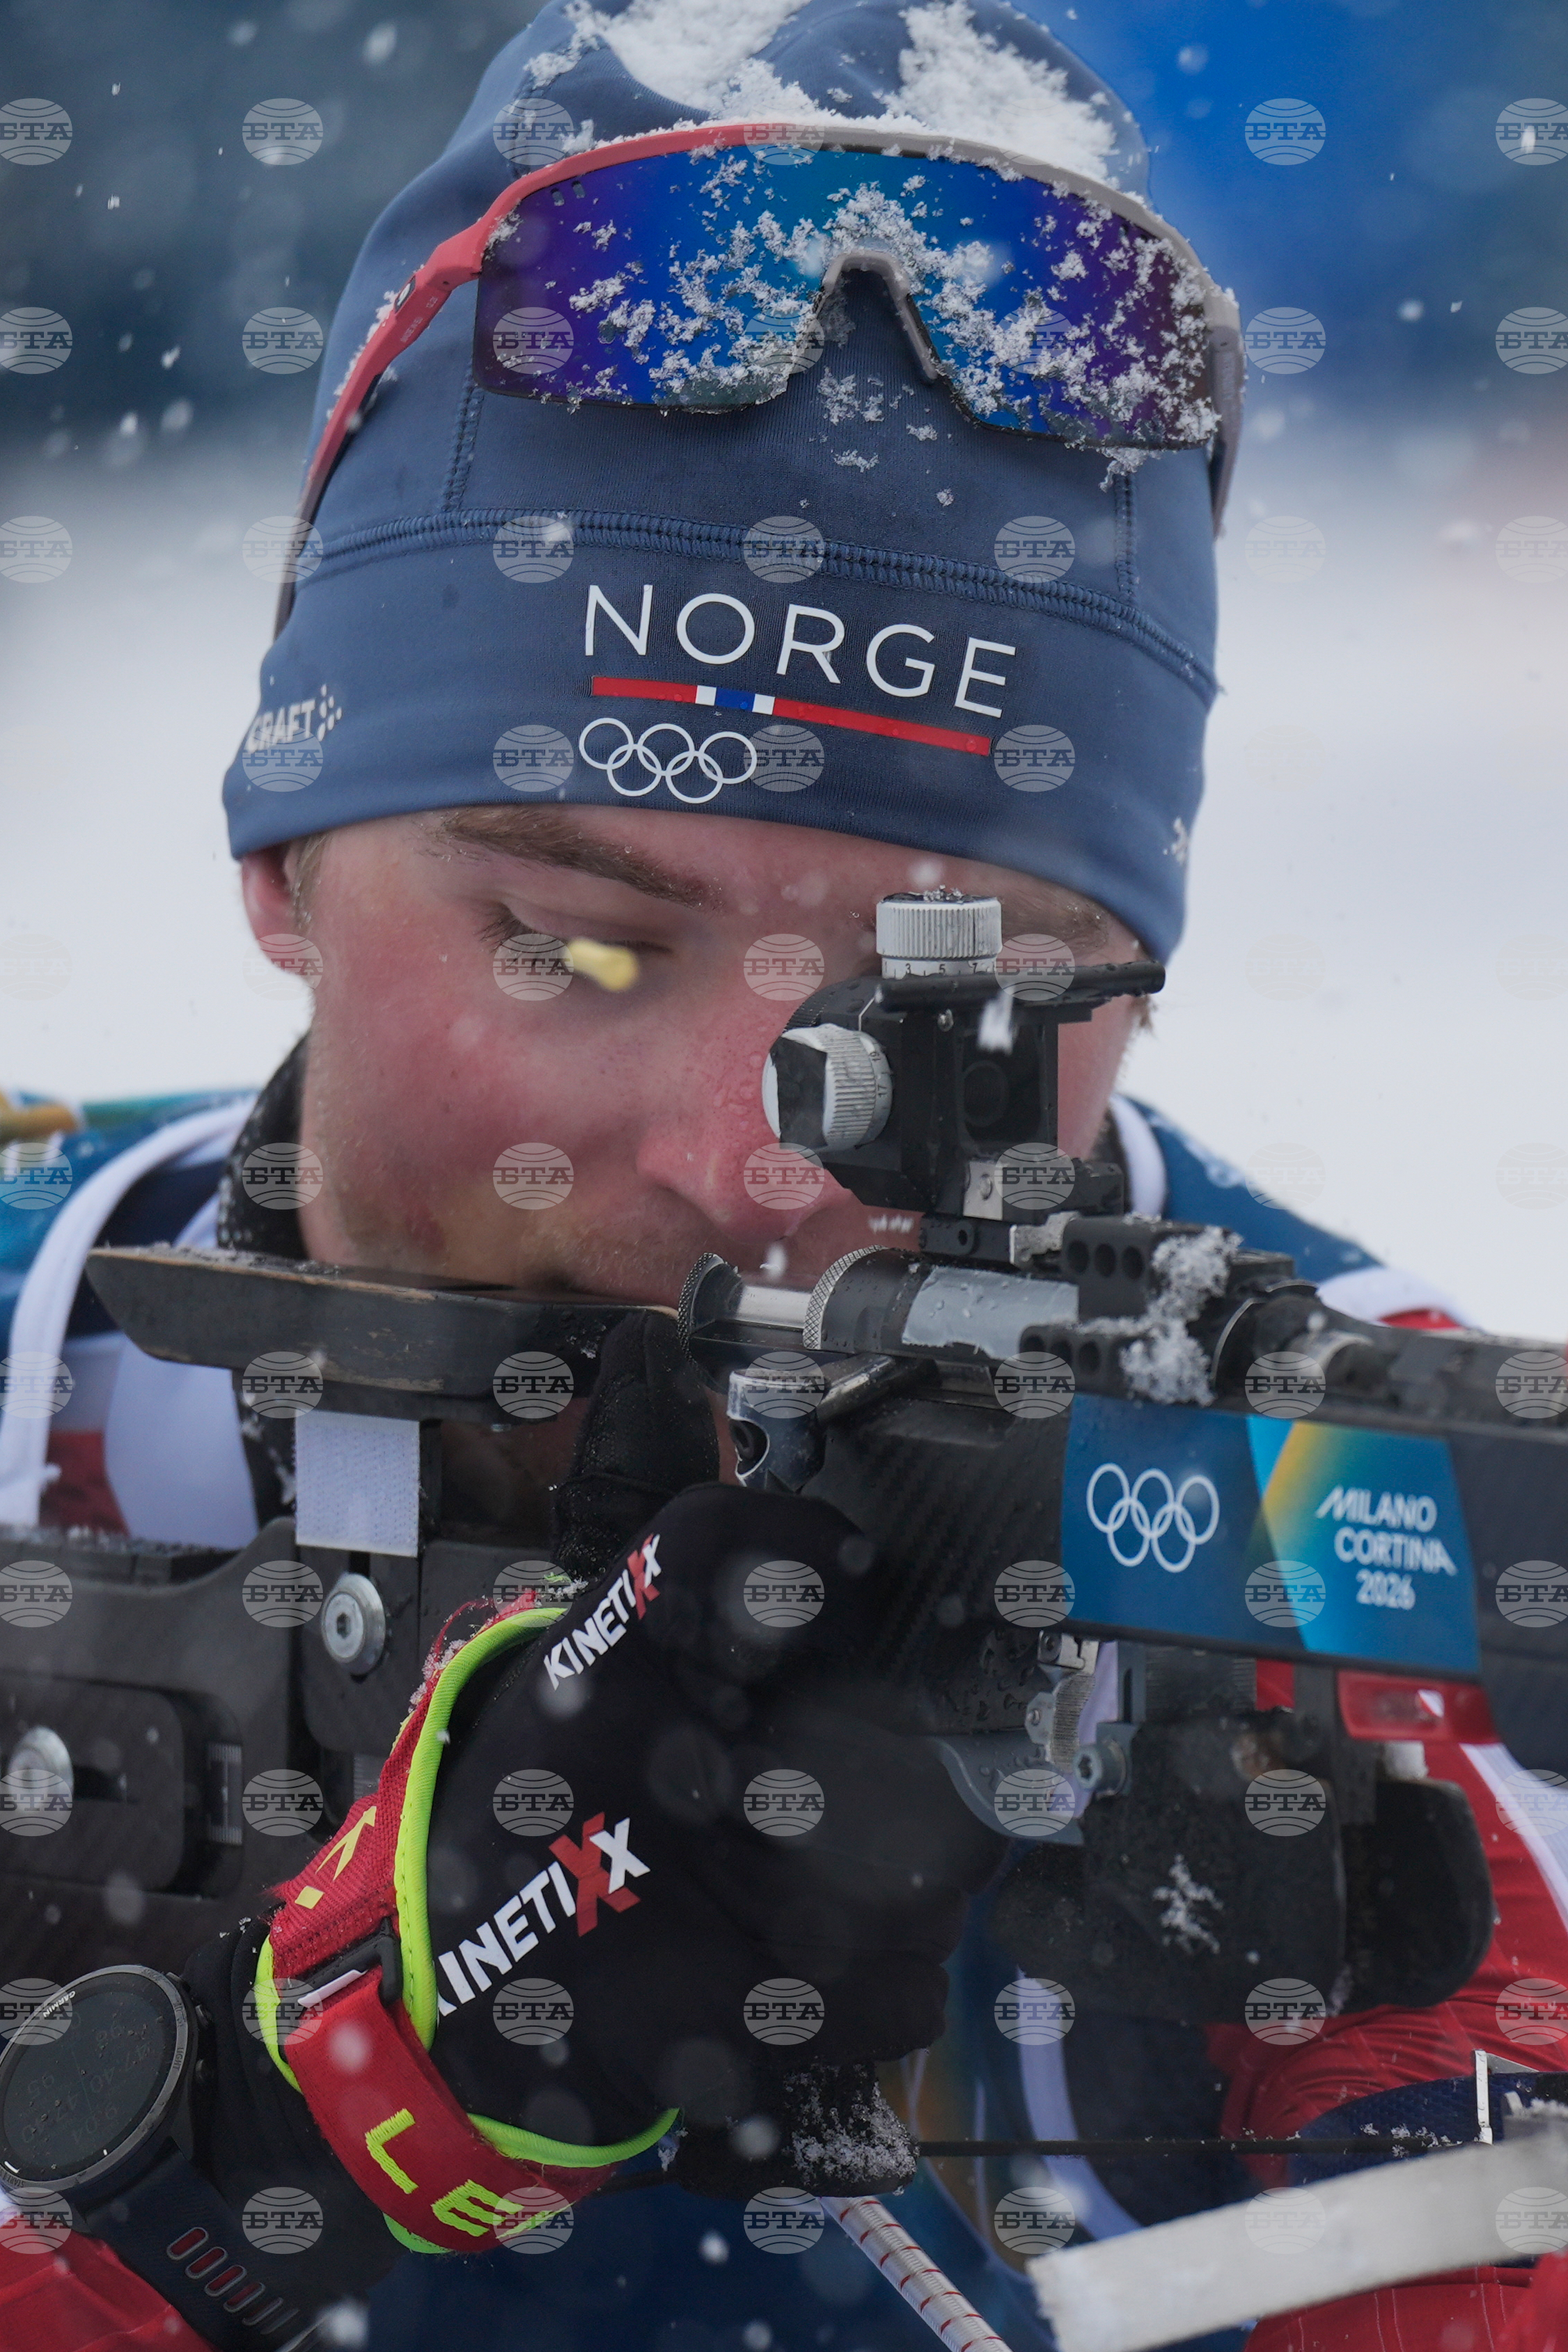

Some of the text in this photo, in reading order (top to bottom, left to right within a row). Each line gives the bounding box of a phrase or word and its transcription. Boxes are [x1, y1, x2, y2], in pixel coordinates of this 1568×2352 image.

[583, 584, 1017, 719] NORGE
[244, 698, 315, 754] CRAFT
[1316, 1484, 1438, 1532] MILANO
[1333, 1526, 1459, 1577] CORTINA
[543, 1533, 662, 1691] KINETIXX
[1356, 1568, 1416, 1610] 2026
[434, 1811, 650, 2017] INETIXX
[42, 1990, 76, 2018] GARMIN
[173, 2046, 185, 2072] LIGHT
[365, 2108, 577, 2239] LE
